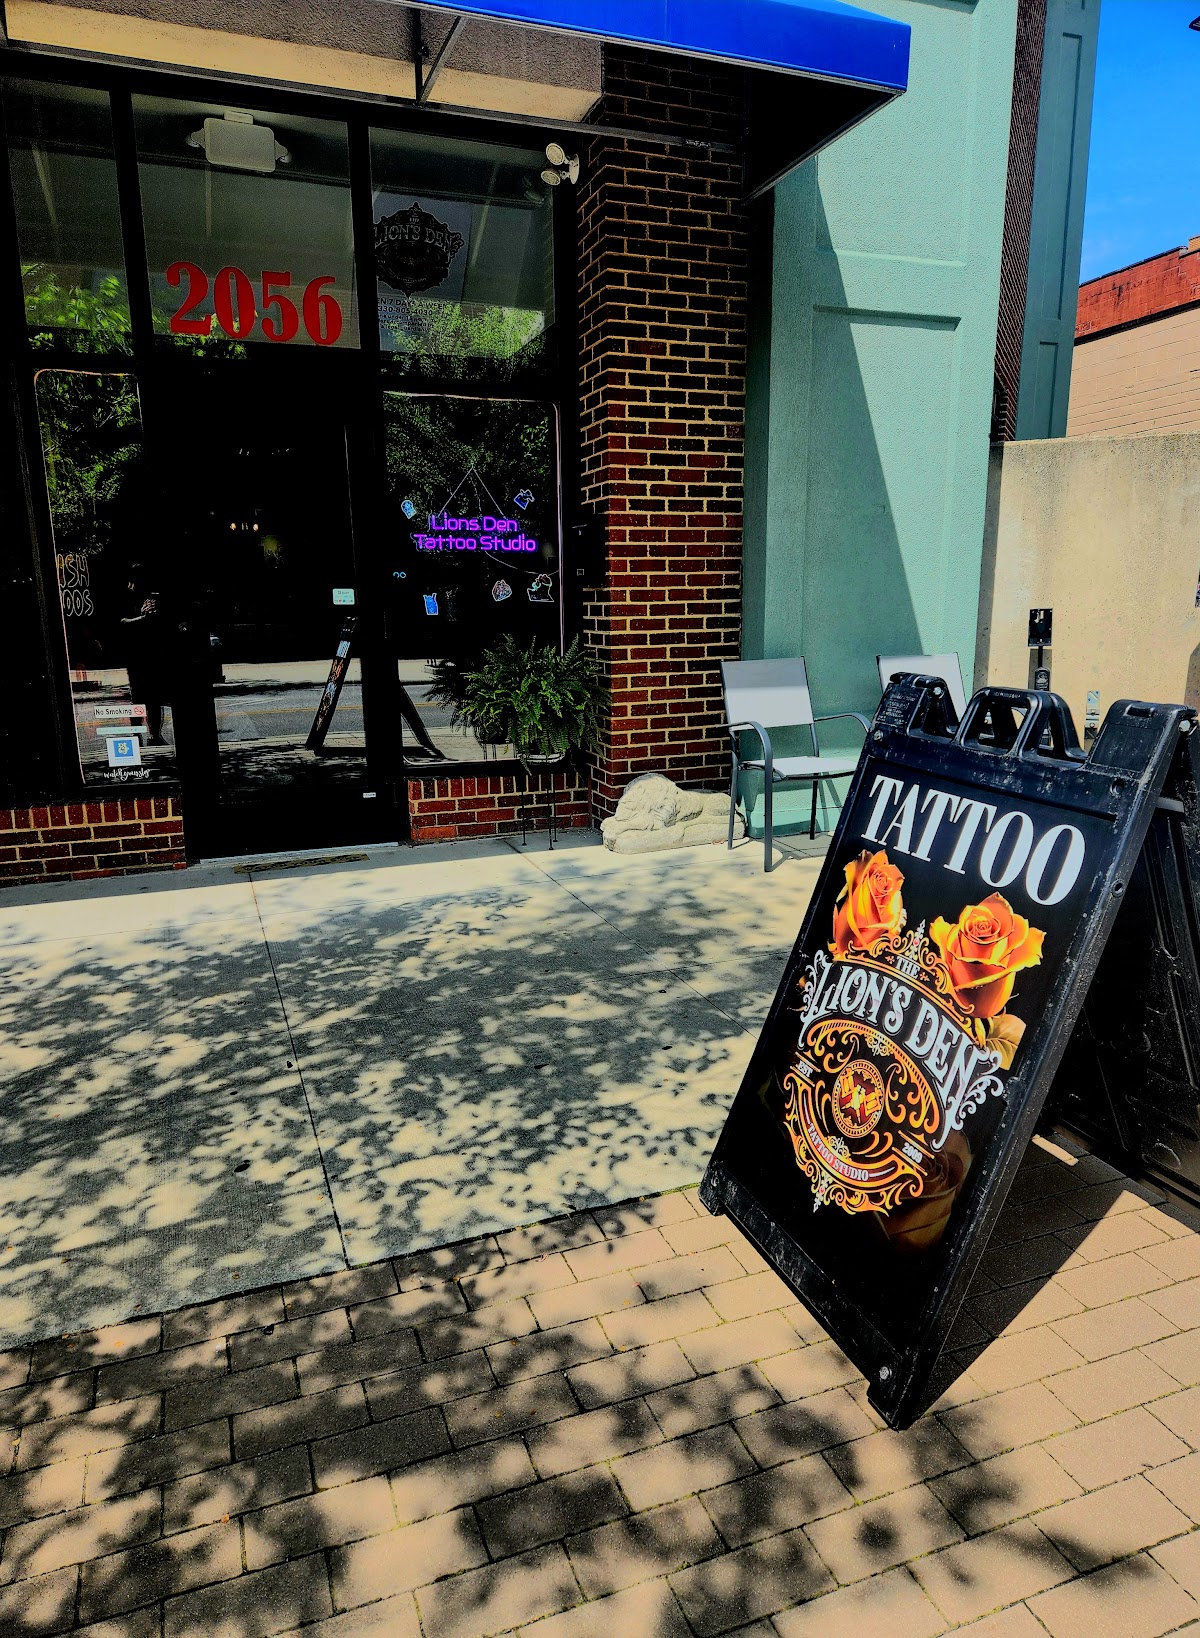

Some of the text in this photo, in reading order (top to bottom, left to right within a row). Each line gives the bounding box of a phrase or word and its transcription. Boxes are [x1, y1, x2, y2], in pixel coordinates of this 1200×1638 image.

[166, 261, 343, 346] 2056
[431, 512, 518, 532] Lions Den
[413, 533, 537, 551] Tattoo Studio
[95, 707, 132, 716] No Smoking
[861, 775, 1086, 906] TATTOO
[895, 956, 921, 979] THE
[800, 952, 988, 1122] LION'S DEN
[797, 1059, 814, 1078] EST
[806, 1122, 870, 1182] TATTOO STUDIO
[901, 1142, 924, 1164] 2009
